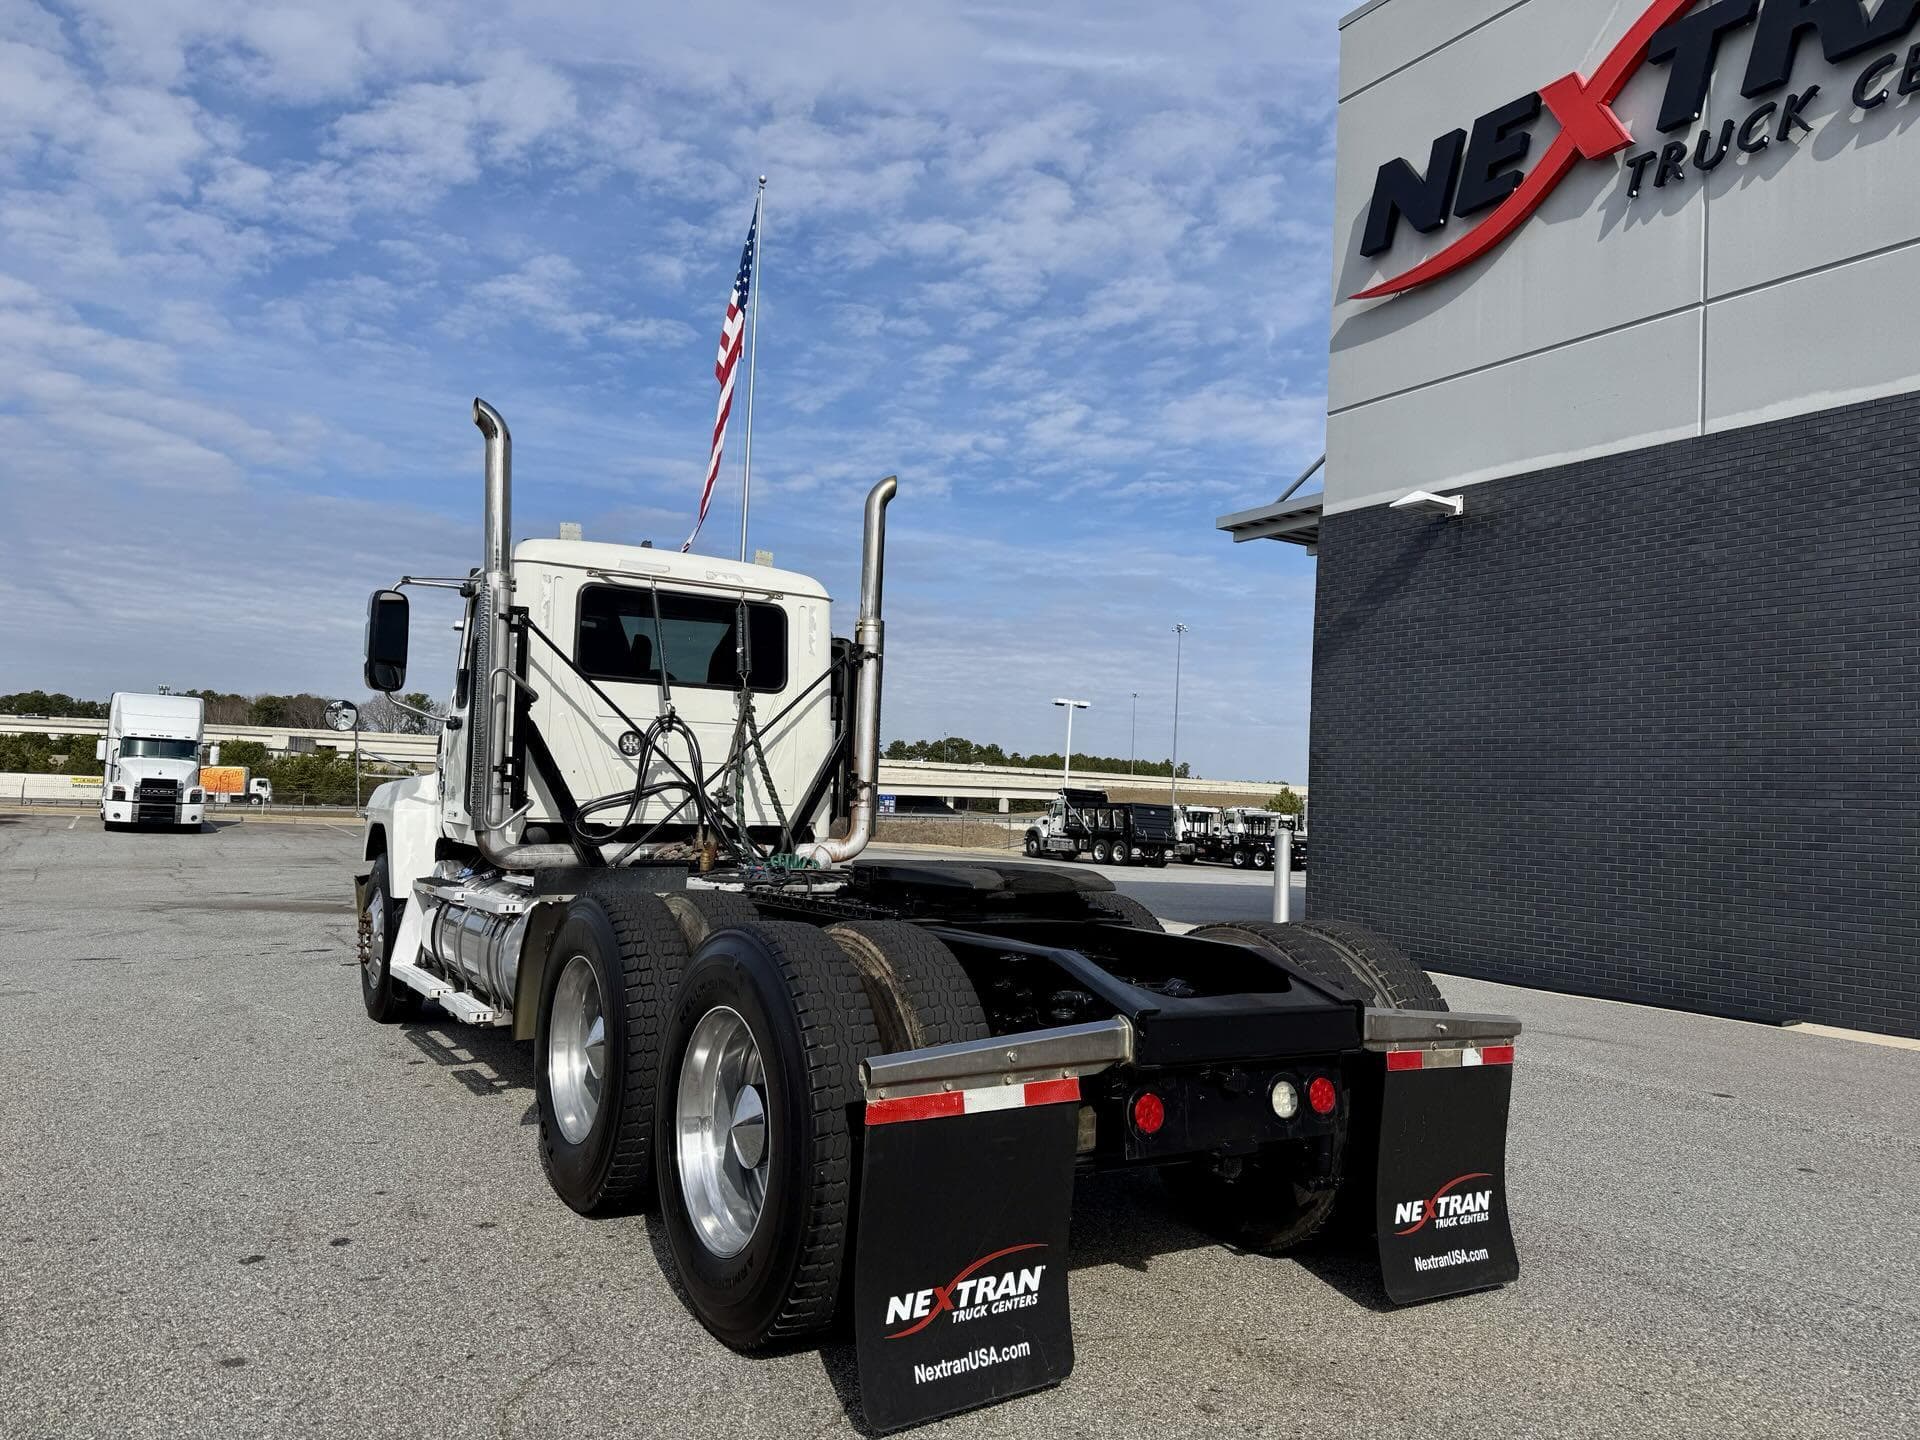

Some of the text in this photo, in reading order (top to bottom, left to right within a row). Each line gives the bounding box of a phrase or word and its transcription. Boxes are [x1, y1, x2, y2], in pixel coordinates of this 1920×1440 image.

[1360, 0, 1920, 258] NEXTR
[1626, 84, 1821, 198] TRUCK
[1394, 1190, 1492, 1225] NEXTRAN
[1435, 1211, 1489, 1229] TRUCK CENTERS
[1414, 1248, 1489, 1272] NextranUSA.com
[885, 1265, 1046, 1325] NEXTRAN
[952, 1293, 1038, 1324] TRUCK CENTERS
[913, 1341, 1031, 1385] NextranUSA.com
